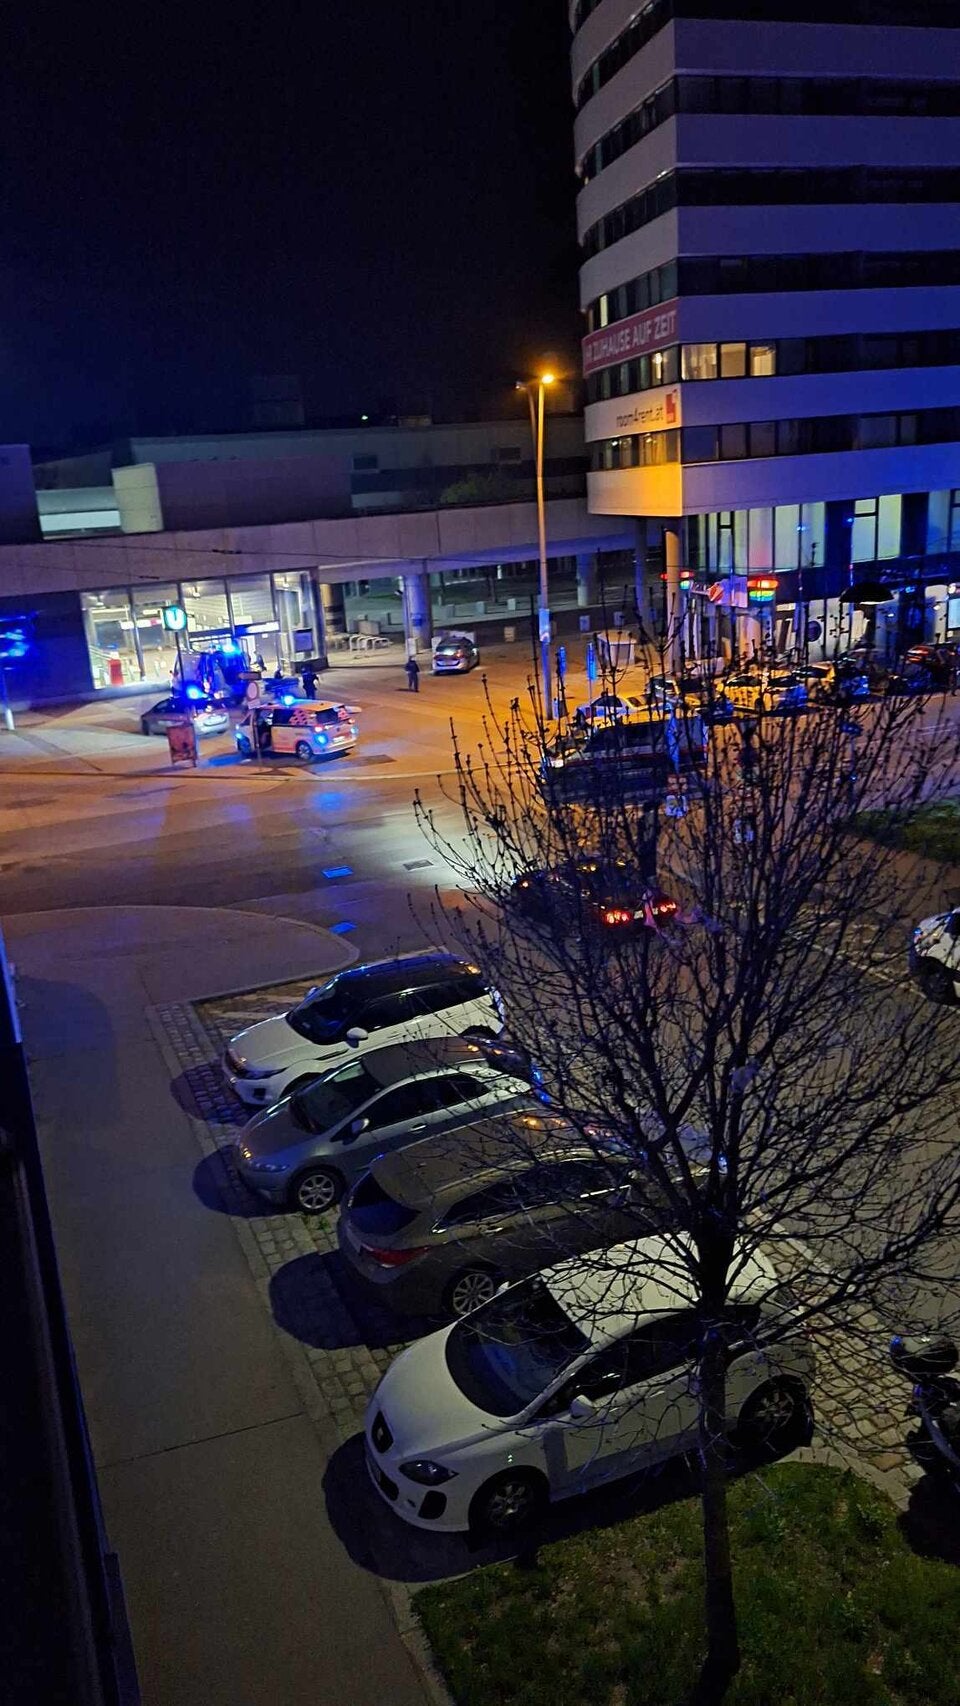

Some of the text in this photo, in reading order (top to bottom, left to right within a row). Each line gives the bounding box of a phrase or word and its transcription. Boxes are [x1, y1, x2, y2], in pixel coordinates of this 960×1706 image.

[593, 327, 631, 361] ZUHAUSE
[632, 319, 653, 348] AUF
[654, 310, 677, 340] ZEIT
[165, 608, 186, 630] U
